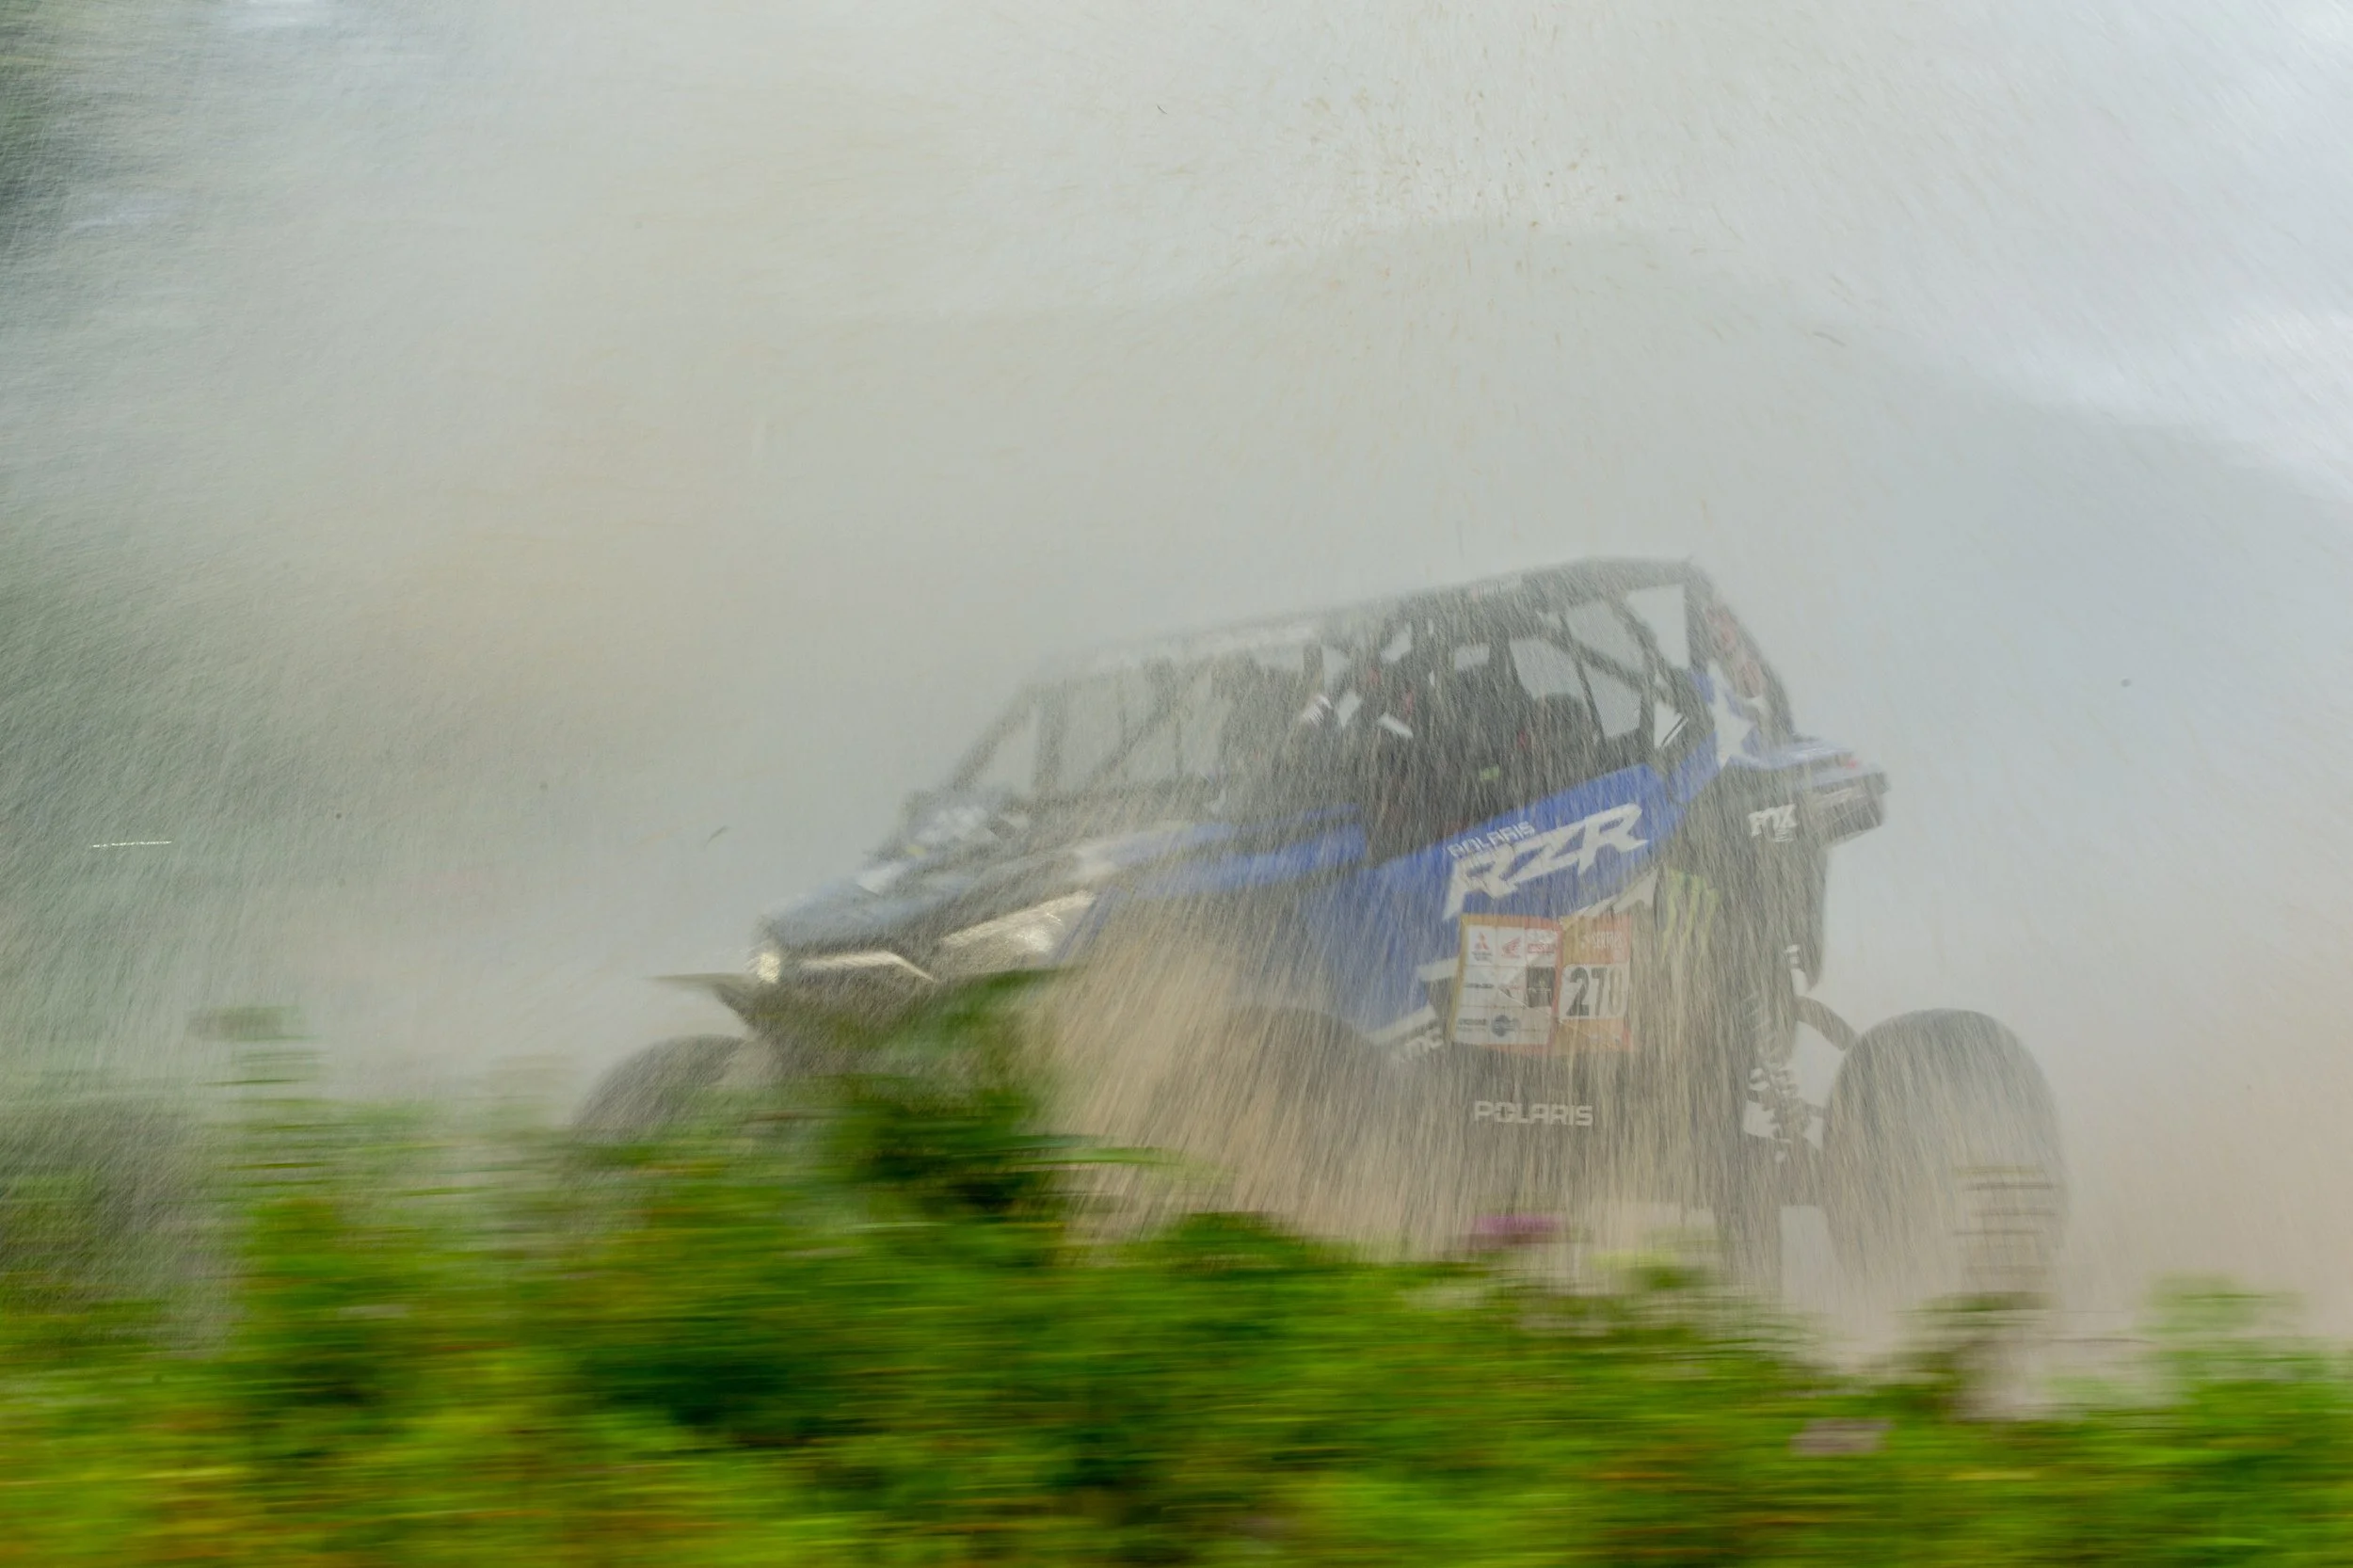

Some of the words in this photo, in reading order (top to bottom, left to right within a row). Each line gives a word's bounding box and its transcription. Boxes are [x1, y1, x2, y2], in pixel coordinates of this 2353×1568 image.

[1448, 821, 1536, 857] POLARIS
[1443, 803, 1649, 921] RZR
[1474, 1100, 1593, 1126] POLARIS
